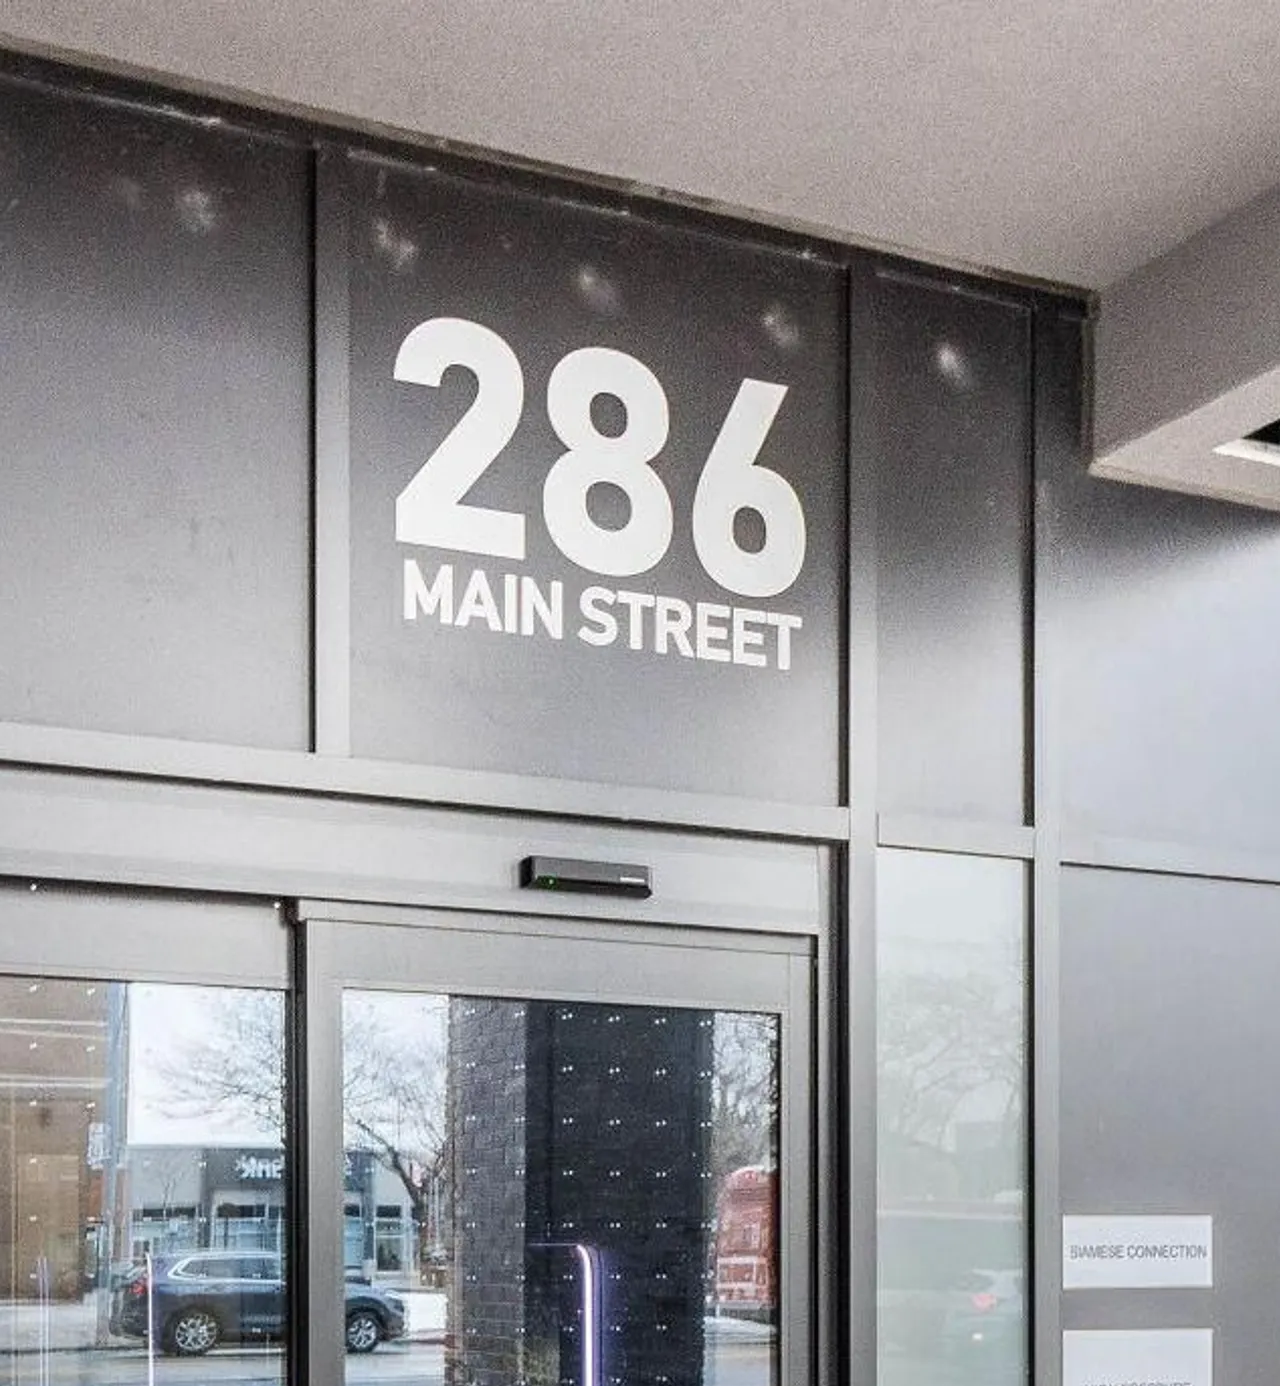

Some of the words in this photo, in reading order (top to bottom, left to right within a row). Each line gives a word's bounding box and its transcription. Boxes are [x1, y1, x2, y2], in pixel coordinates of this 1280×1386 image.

[393, 316, 807, 598] 286
[402, 558, 564, 640] MAIN
[577, 585, 803, 671] STREET
[1070, 1244, 1124, 1259] SIAMESE
[1126, 1244, 1208, 1259] CONNECTION
